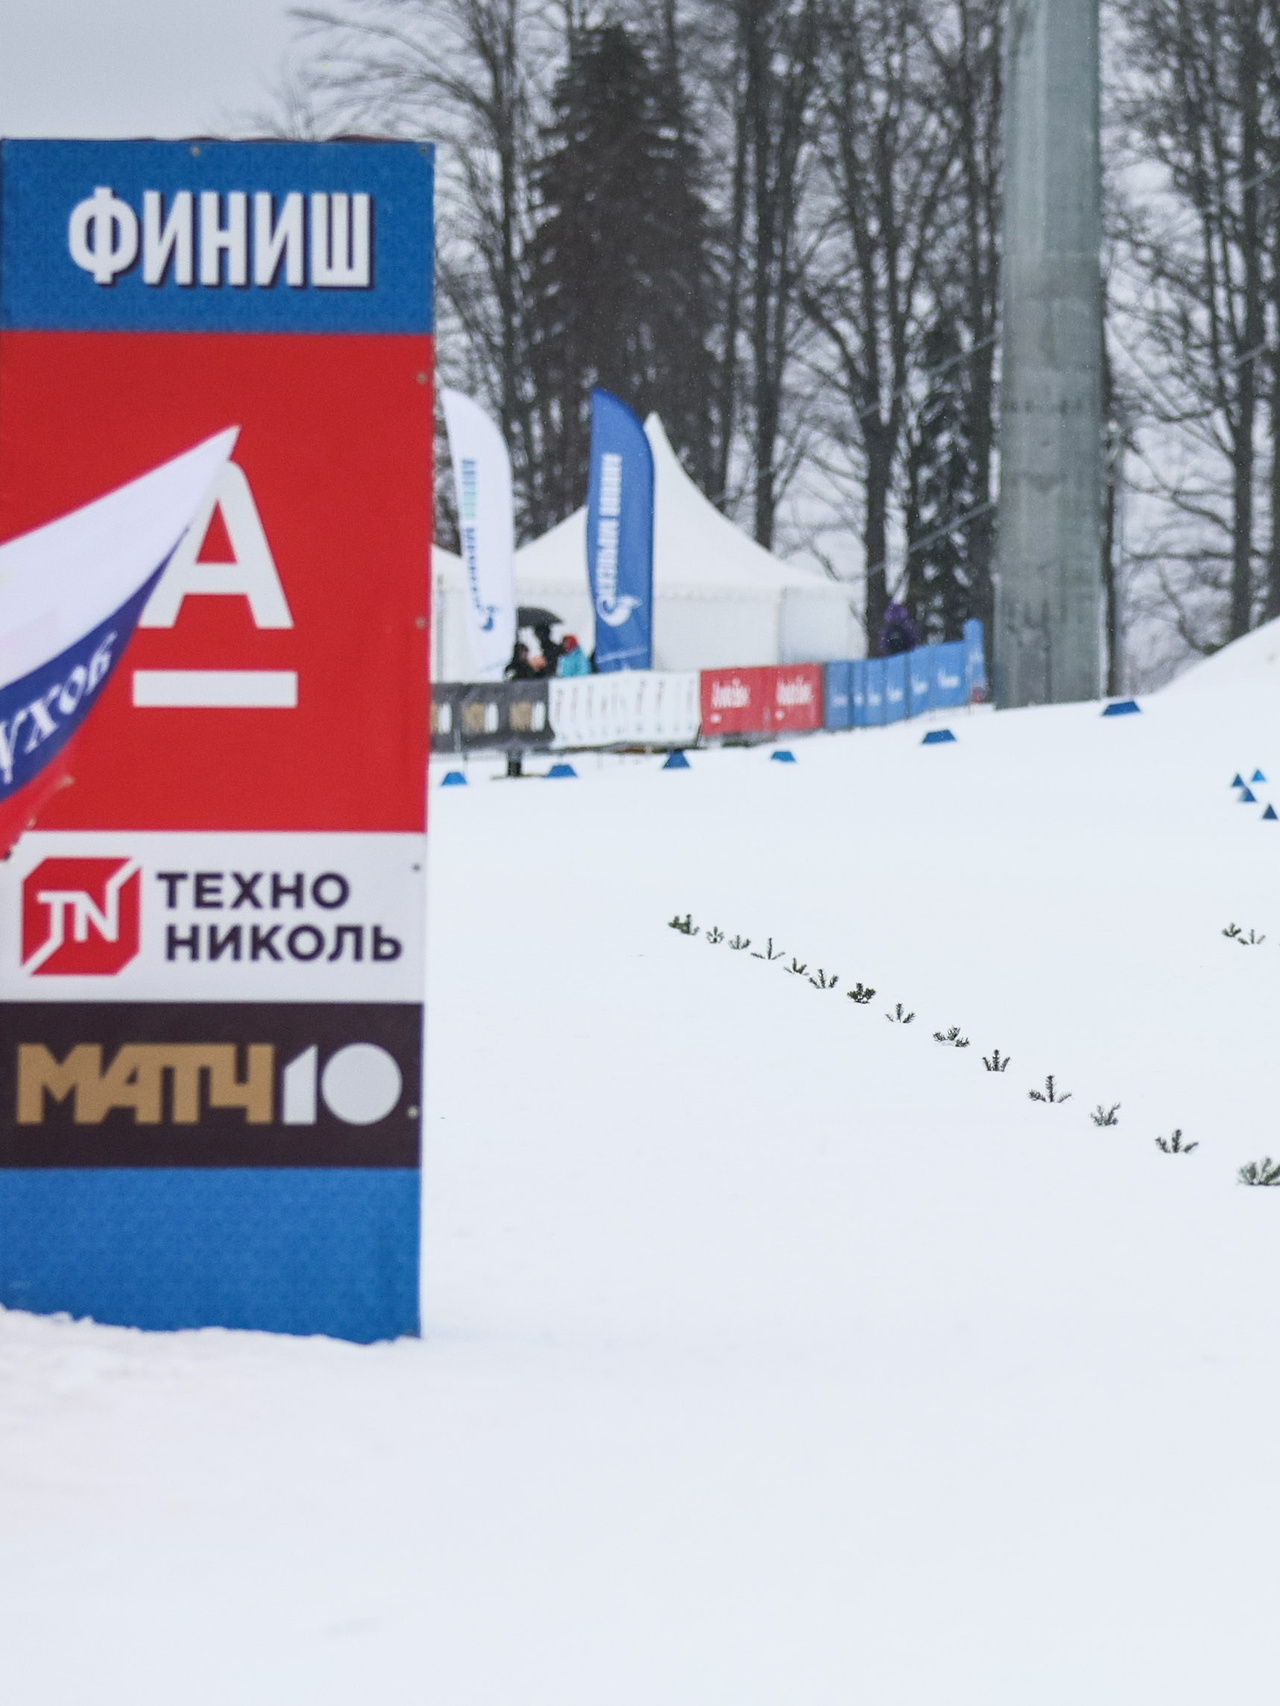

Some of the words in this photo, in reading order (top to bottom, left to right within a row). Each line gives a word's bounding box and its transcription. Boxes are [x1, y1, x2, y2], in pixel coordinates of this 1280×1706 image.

[68, 186, 373, 289] ФИНИШ
[156, 871, 351, 910] ТЕХНО
[165, 924, 403, 963] НИКОЛЬ
